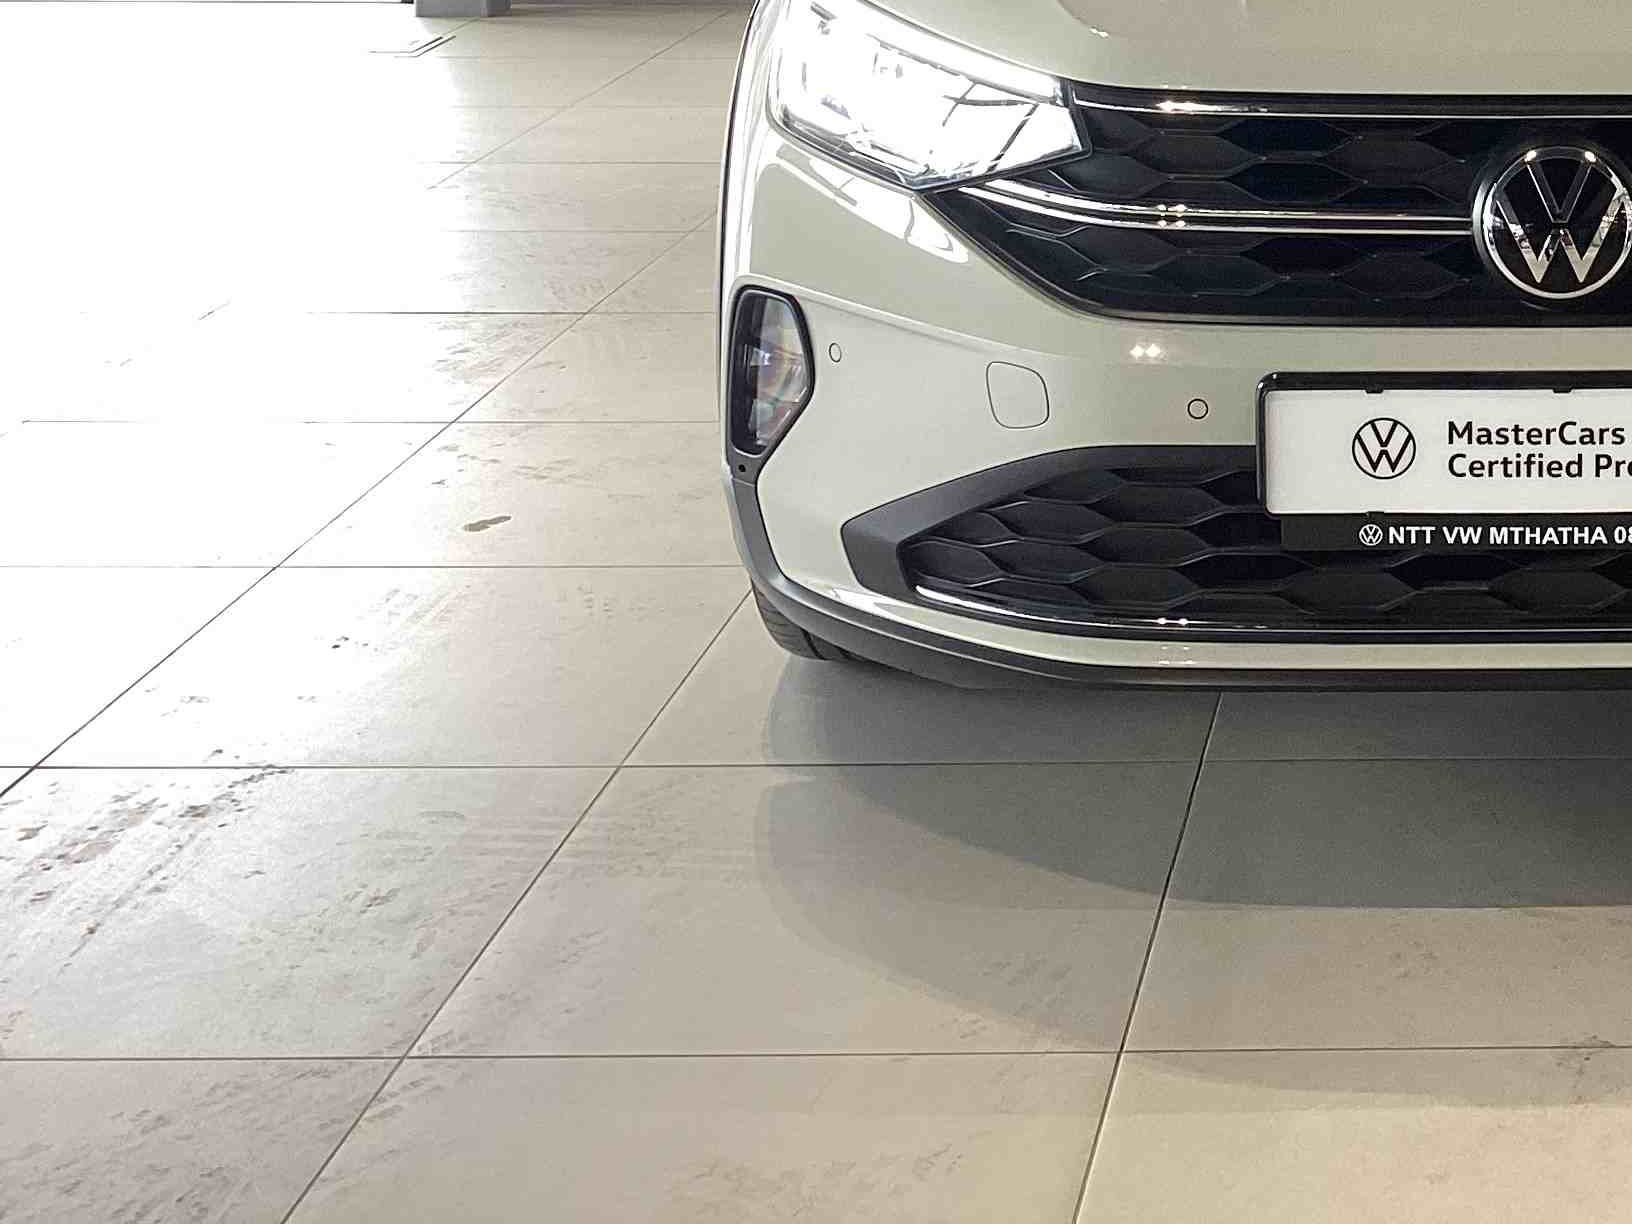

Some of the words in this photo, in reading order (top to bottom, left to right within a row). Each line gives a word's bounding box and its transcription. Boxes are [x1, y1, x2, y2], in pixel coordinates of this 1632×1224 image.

[1447, 421, 1626, 446] MasterCars
[1448, 453, 1583, 478] Certified
[1389, 527, 1436, 544] NTT
[1442, 527, 1483, 544] VW
[1489, 527, 1608, 545] MTHATHA
